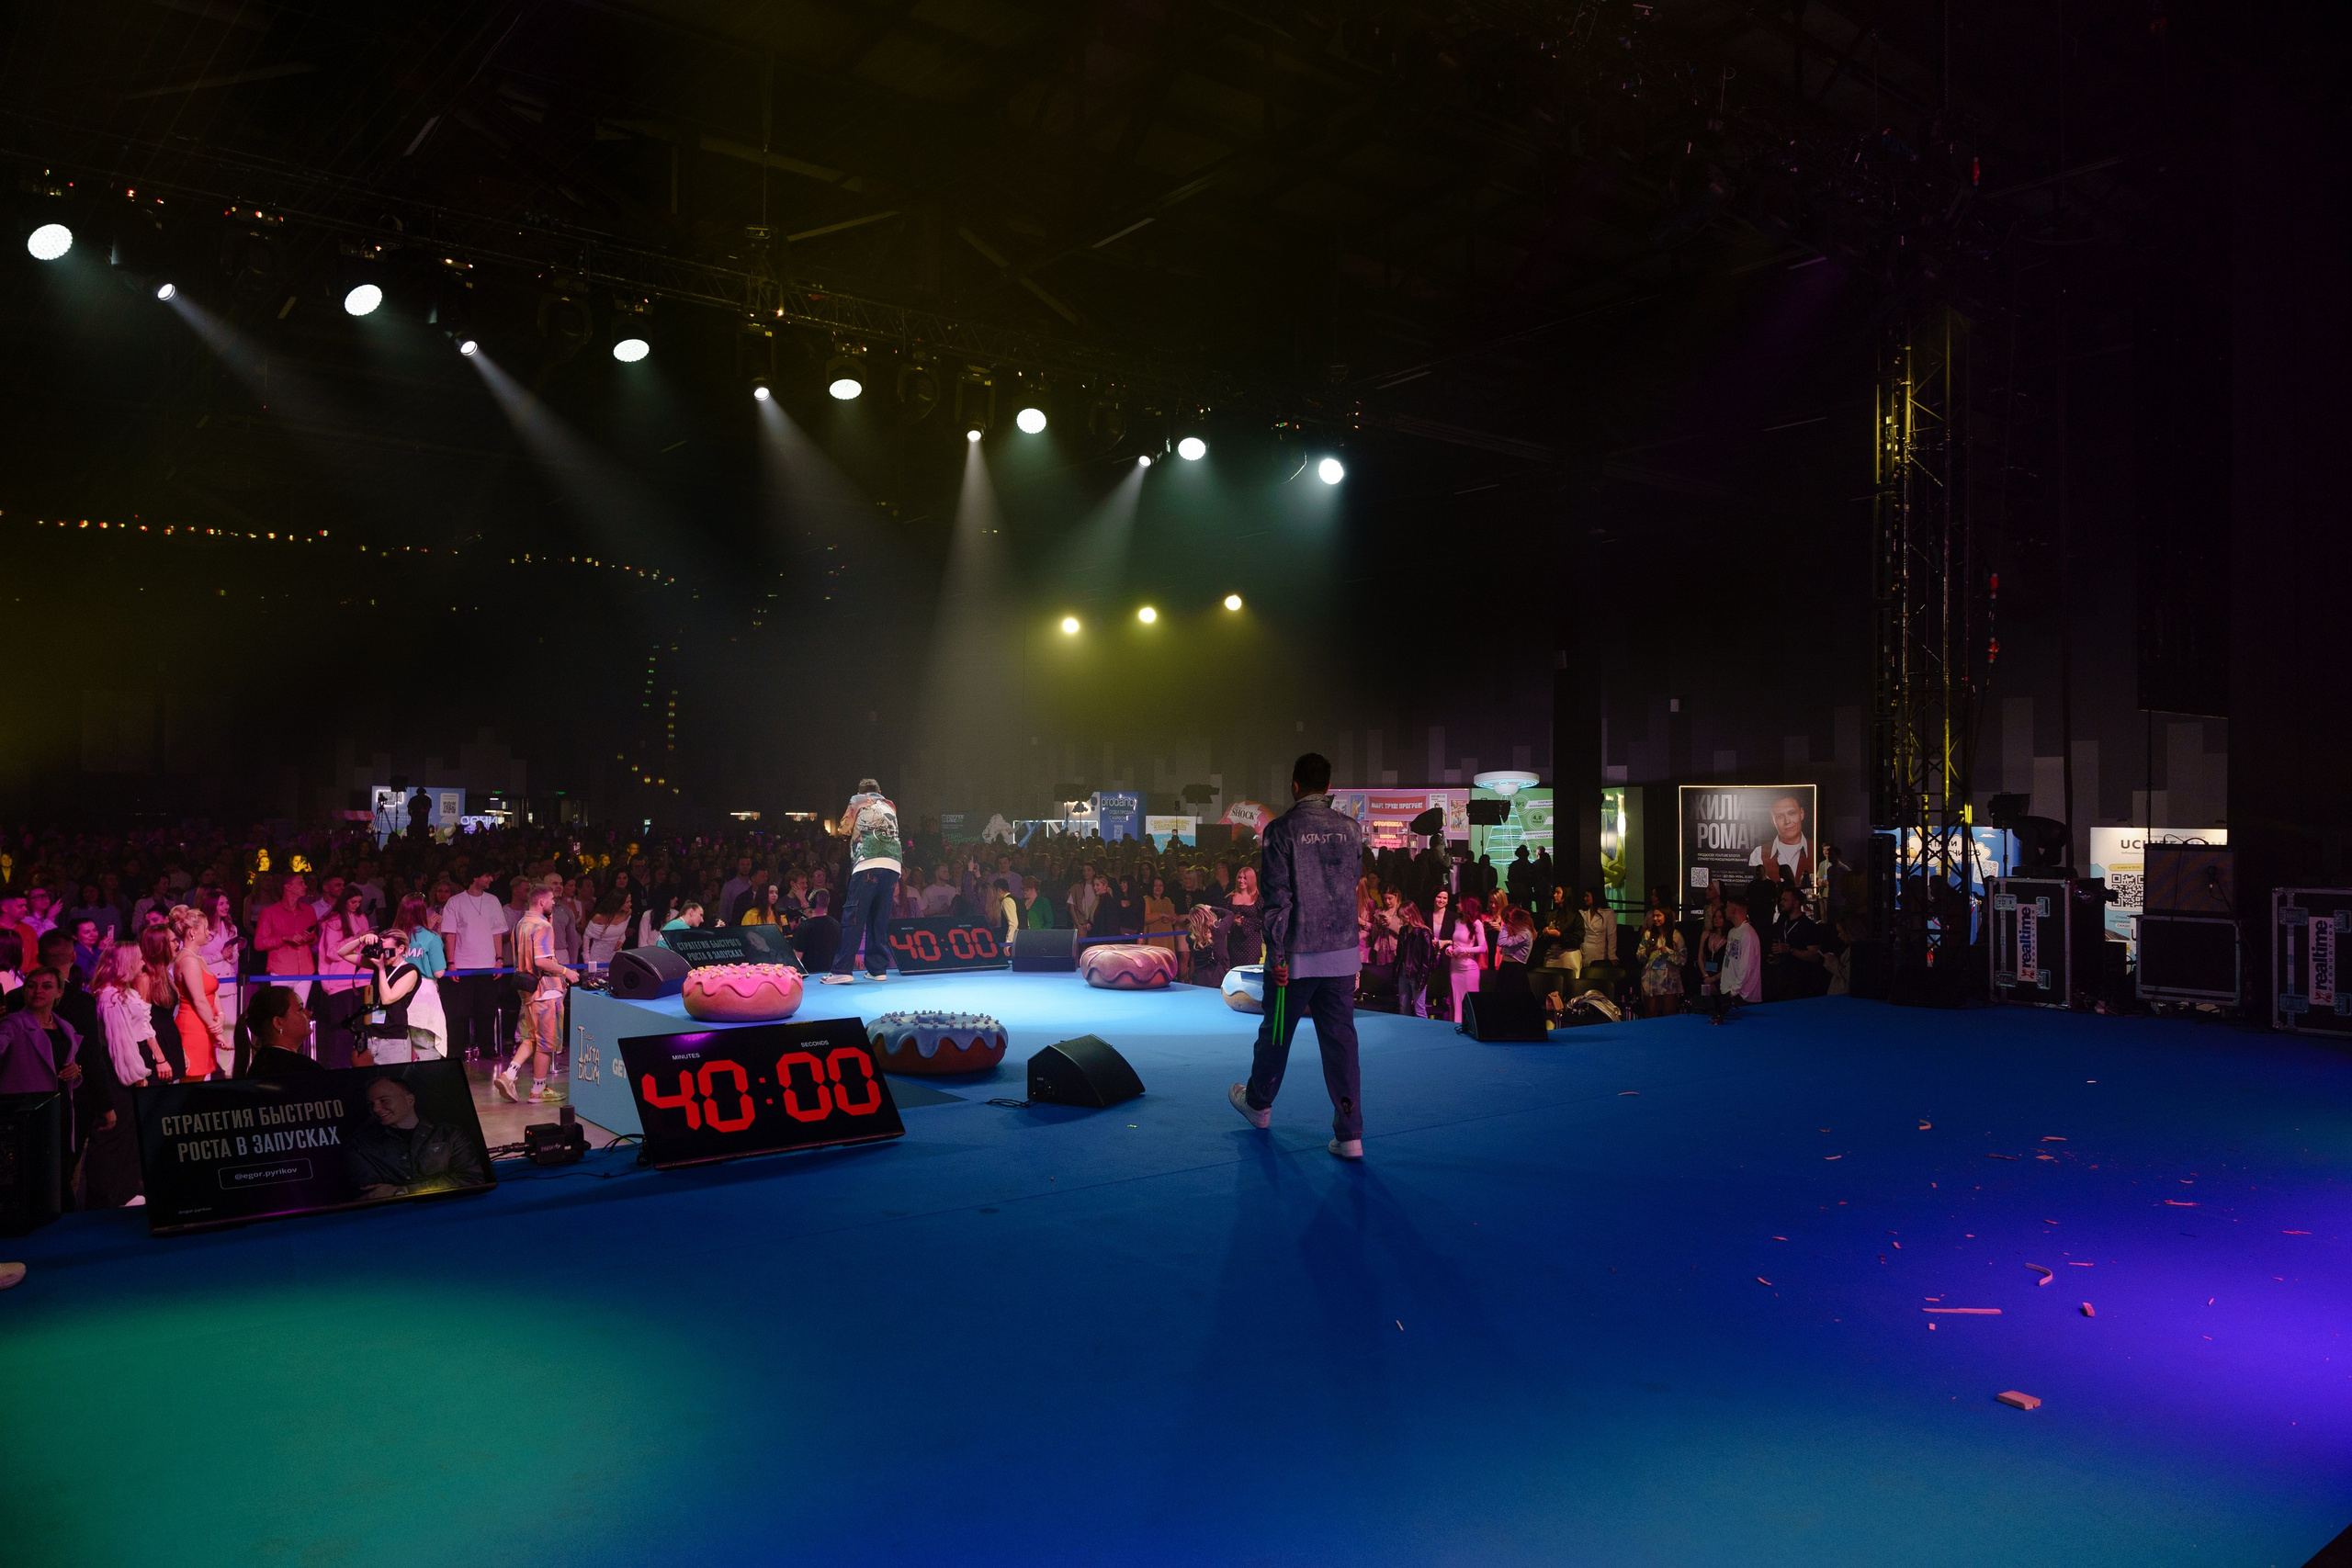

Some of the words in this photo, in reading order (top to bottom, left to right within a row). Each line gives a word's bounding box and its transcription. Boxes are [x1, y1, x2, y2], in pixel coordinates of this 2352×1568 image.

[889, 928, 998, 962] 40:00
[2018, 907, 2031, 968] realtime
[2312, 920, 2327, 990] realtime
[687, 952, 708, 962] РОСТА
[672, 1052, 700, 1060] MINUTES
[800, 1040, 830, 1048] SECONDS
[641, 1046, 882, 1134] 40:00
[162, 1108, 254, 1136] СТРАТЕГИЯ
[258, 1099, 345, 1126] БЫСТРОГО
[177, 1138, 232, 1163] РОСТА
[236, 1136, 248, 1156] В
[252, 1125, 341, 1154] ЗАПУСКАХ
[234, 1167, 298, 1180] @egor.pyrikov
